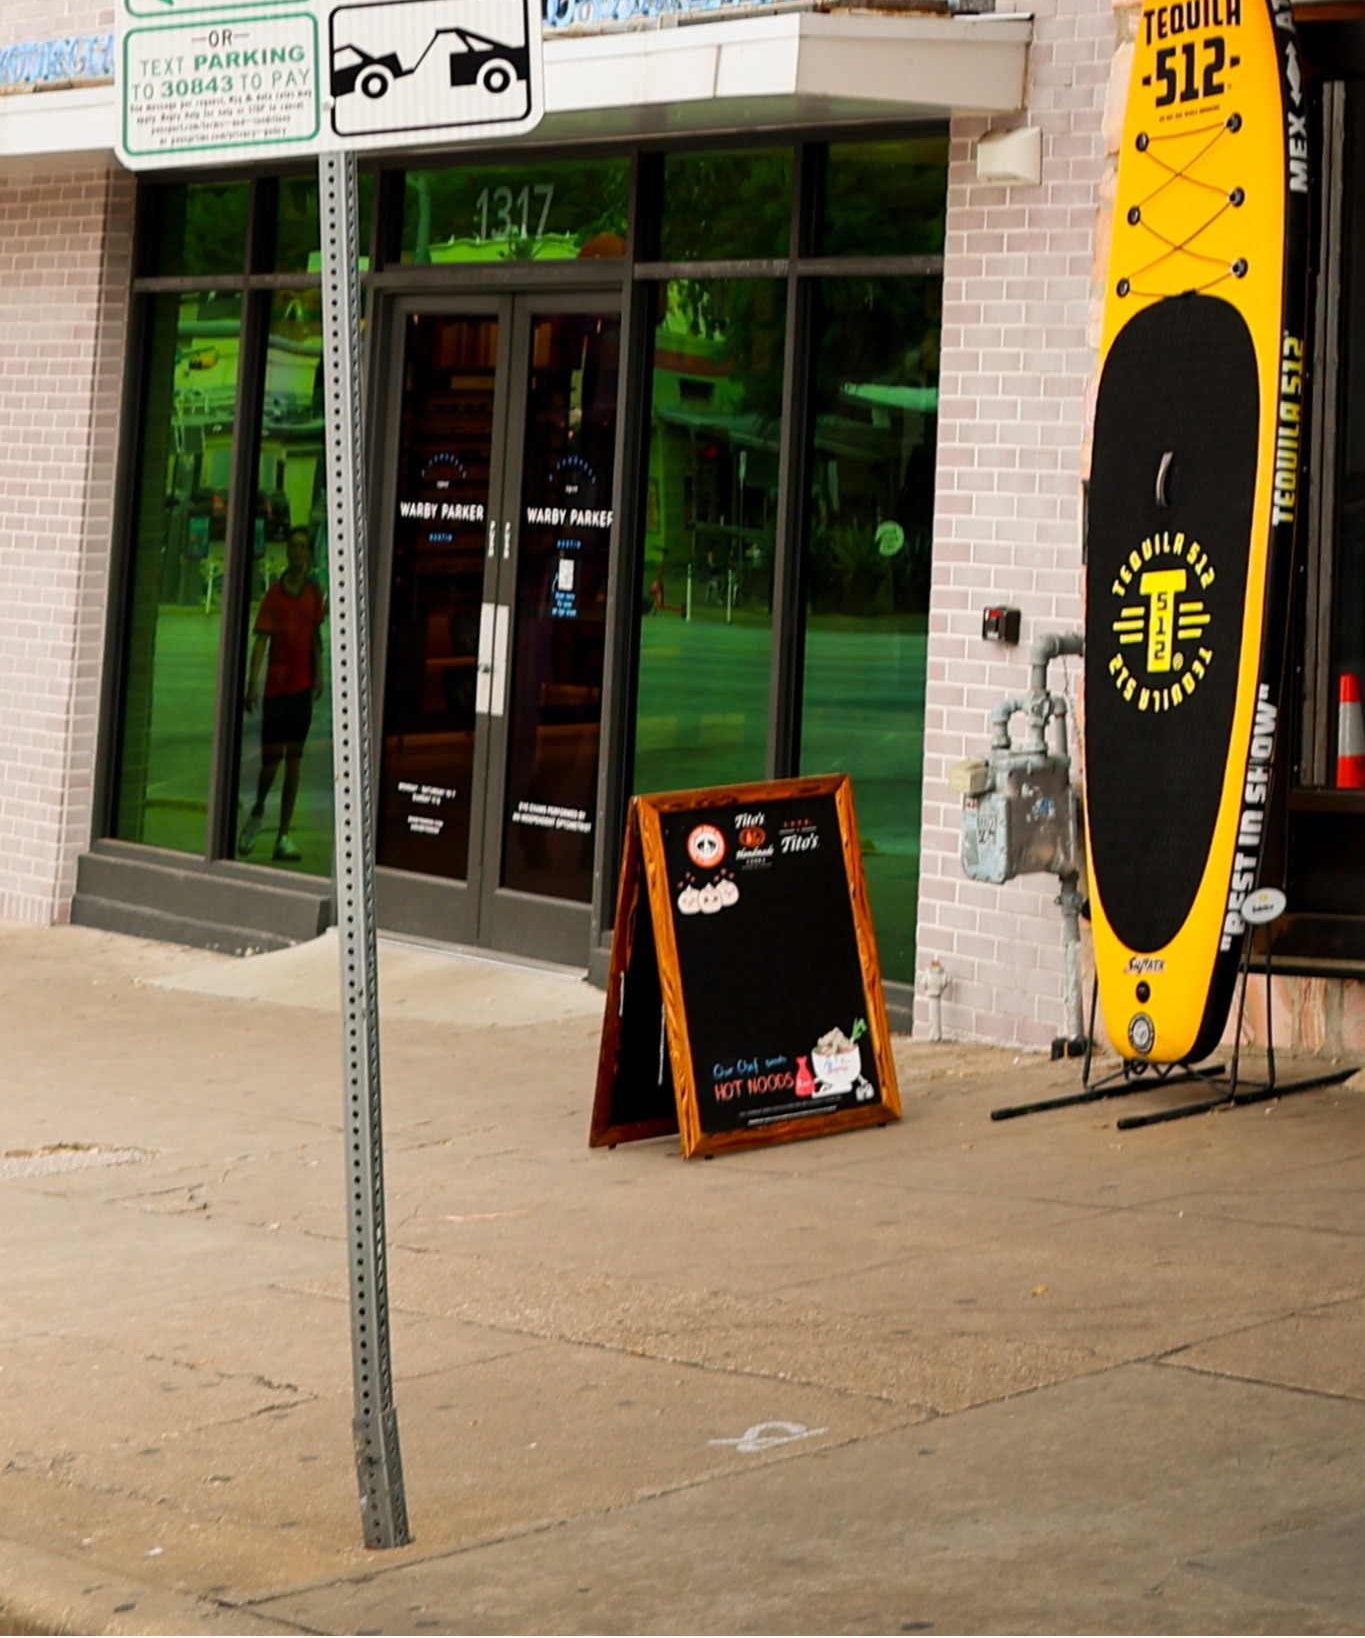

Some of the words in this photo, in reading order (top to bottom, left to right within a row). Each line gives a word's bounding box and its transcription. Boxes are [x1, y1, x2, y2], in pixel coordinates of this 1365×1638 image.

[140, 56, 185, 77] TEXT
[194, 45, 306, 72] PARKING
[132, 83, 155, 102] TO
[161, 75, 234, 98] 30843
[240, 73, 263, 92] TO
[272, 68, 311, 89] PAY
[1288, 112, 1308, 193] MEX
[476, 183, 554, 241] 1317
[1281, 336, 1304, 396] 512
[1272, 401, 1301, 527] TEQUILA
[400, 501, 440, 519] WARBY
[441, 504, 485, 522] PARKER
[526, 507, 567, 525] WARBY
[1112, 531, 1185, 597] TEQUILA
[1186, 541, 1215, 590] 512
[734, 811, 766, 830] Tito's
[1238, 810, 1264, 846] IN
[780, 832, 820, 854] Tito's
[715, 1079, 744, 1103] HOT
[747, 1072, 795, 1095] NOODS
